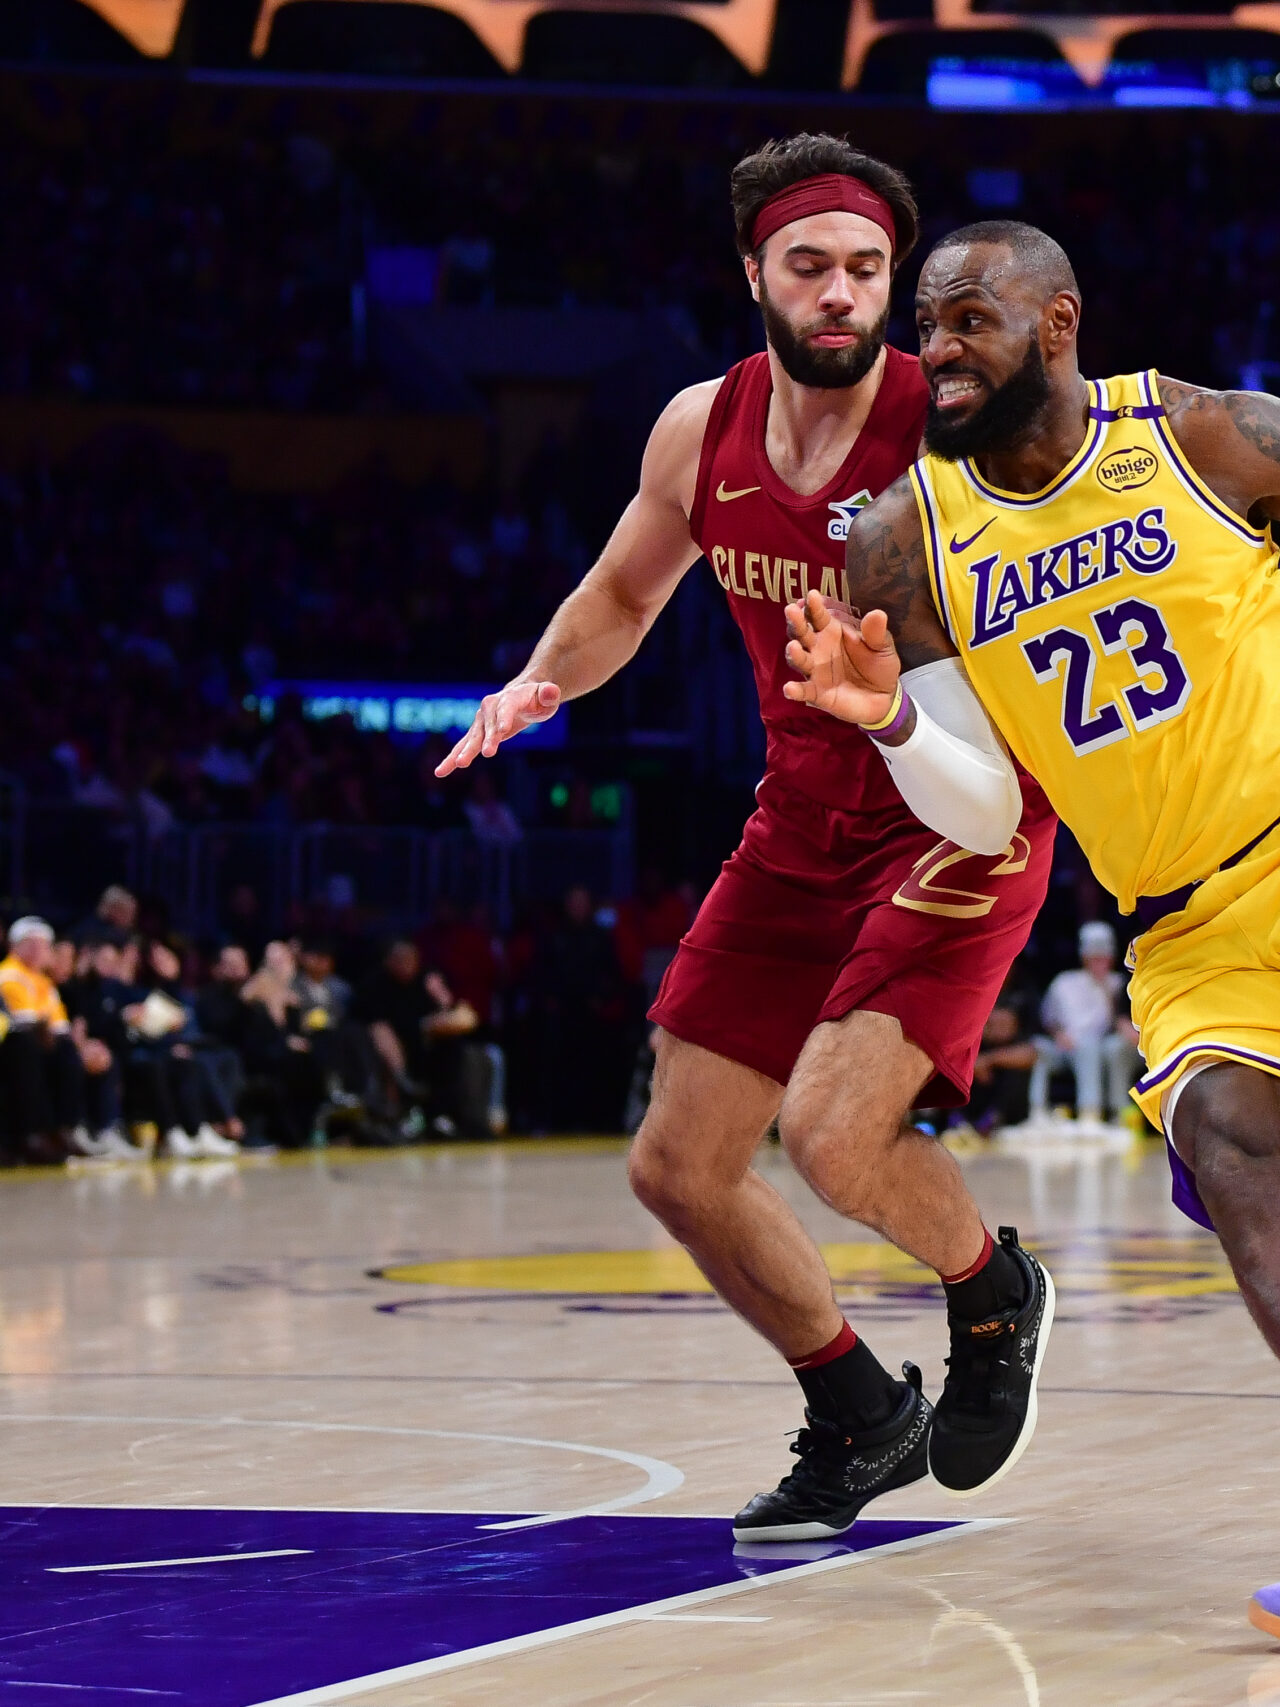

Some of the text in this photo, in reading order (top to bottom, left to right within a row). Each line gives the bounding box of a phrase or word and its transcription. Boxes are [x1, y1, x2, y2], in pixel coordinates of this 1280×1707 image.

[1101, 457, 1154, 480] bibigo
[830, 523, 850, 536] CL
[967, 505, 1179, 651] LAKERS
[1018, 595, 1193, 758] 23
